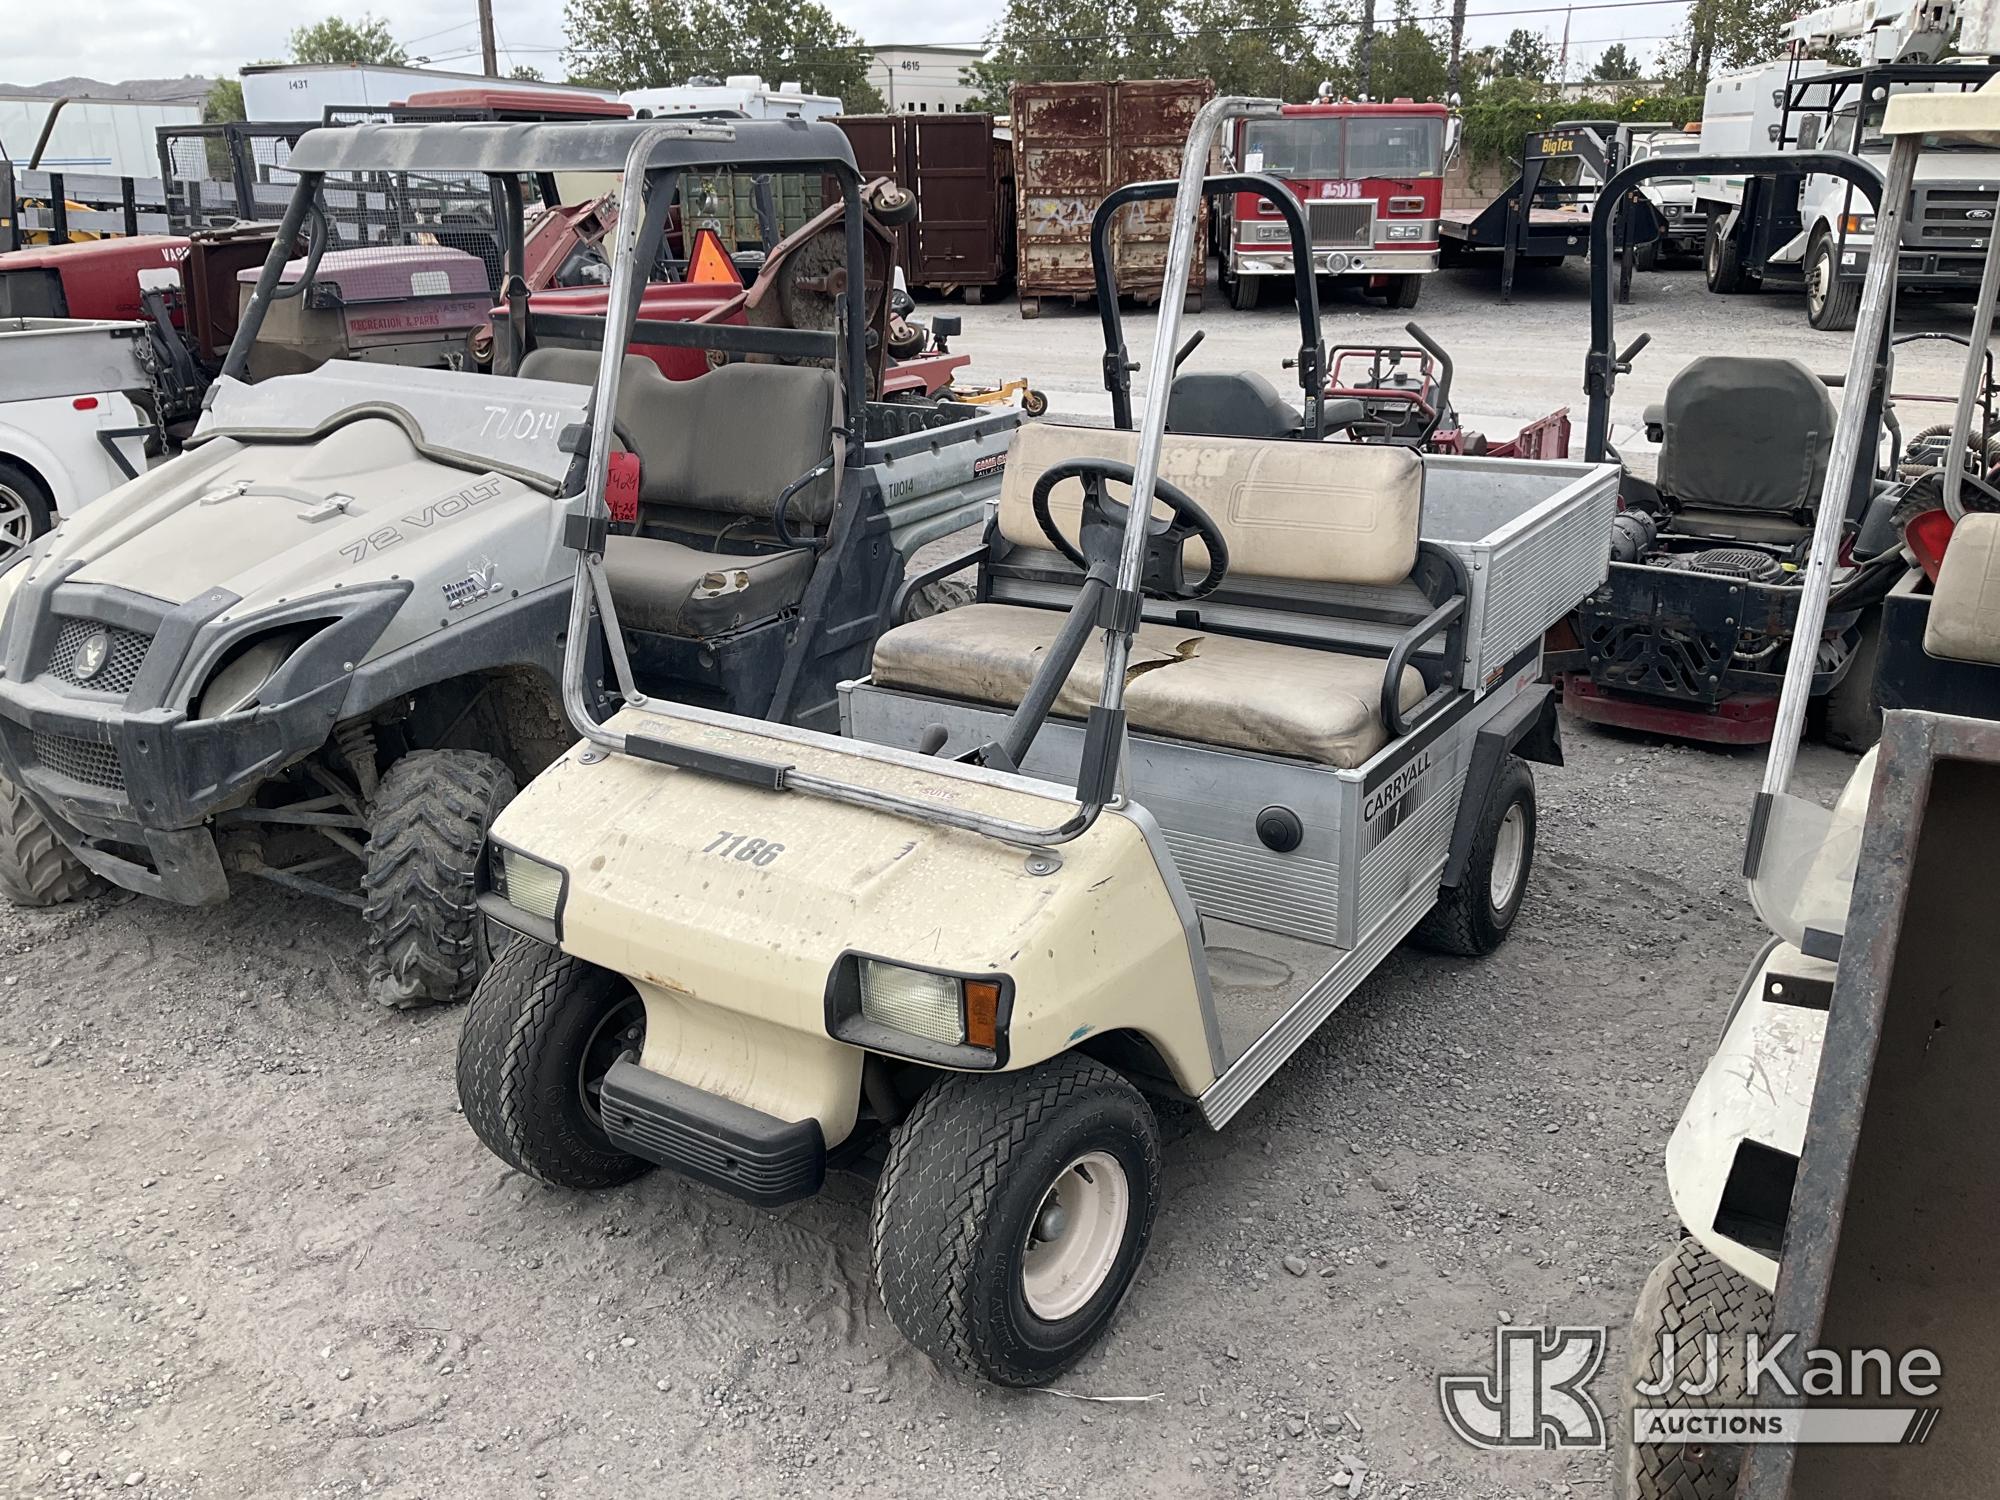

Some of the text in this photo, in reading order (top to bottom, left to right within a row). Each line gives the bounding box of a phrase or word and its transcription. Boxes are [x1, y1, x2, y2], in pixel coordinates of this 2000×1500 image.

[901, 60, 920, 71] 4615
[350, 315, 402, 332] RECREATION
[413, 314, 440, 327] PARKS
[888, 478, 914, 500] TU014
[339, 477, 501, 564] 72 VOLT
[1364, 752, 1432, 822] CARRYALL
[702, 830, 786, 867] 7186
